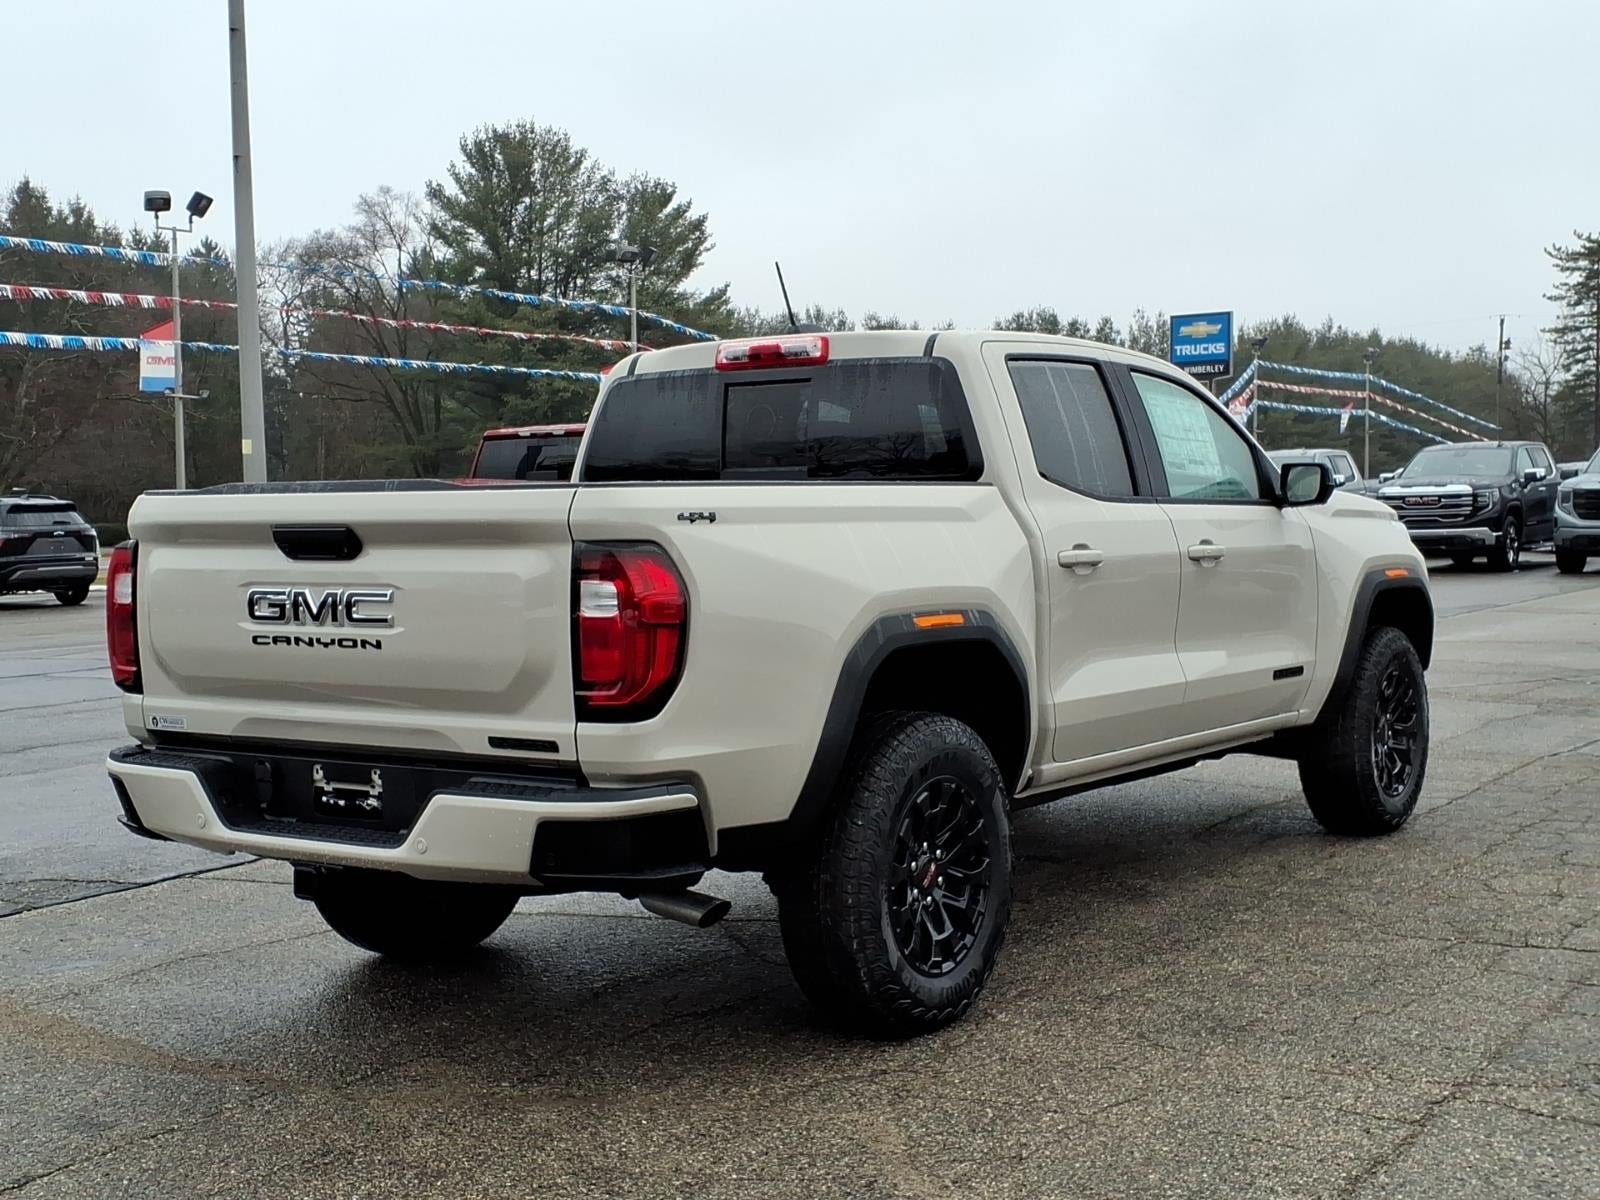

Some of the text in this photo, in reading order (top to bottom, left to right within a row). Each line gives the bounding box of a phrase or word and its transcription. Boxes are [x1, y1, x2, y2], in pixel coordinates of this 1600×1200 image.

[1174, 342, 1225, 356] TRUCKS
[1184, 364, 1224, 374] WIMBERLEY
[247, 588, 395, 628] GMC
[251, 635, 382, 650] CANYON
